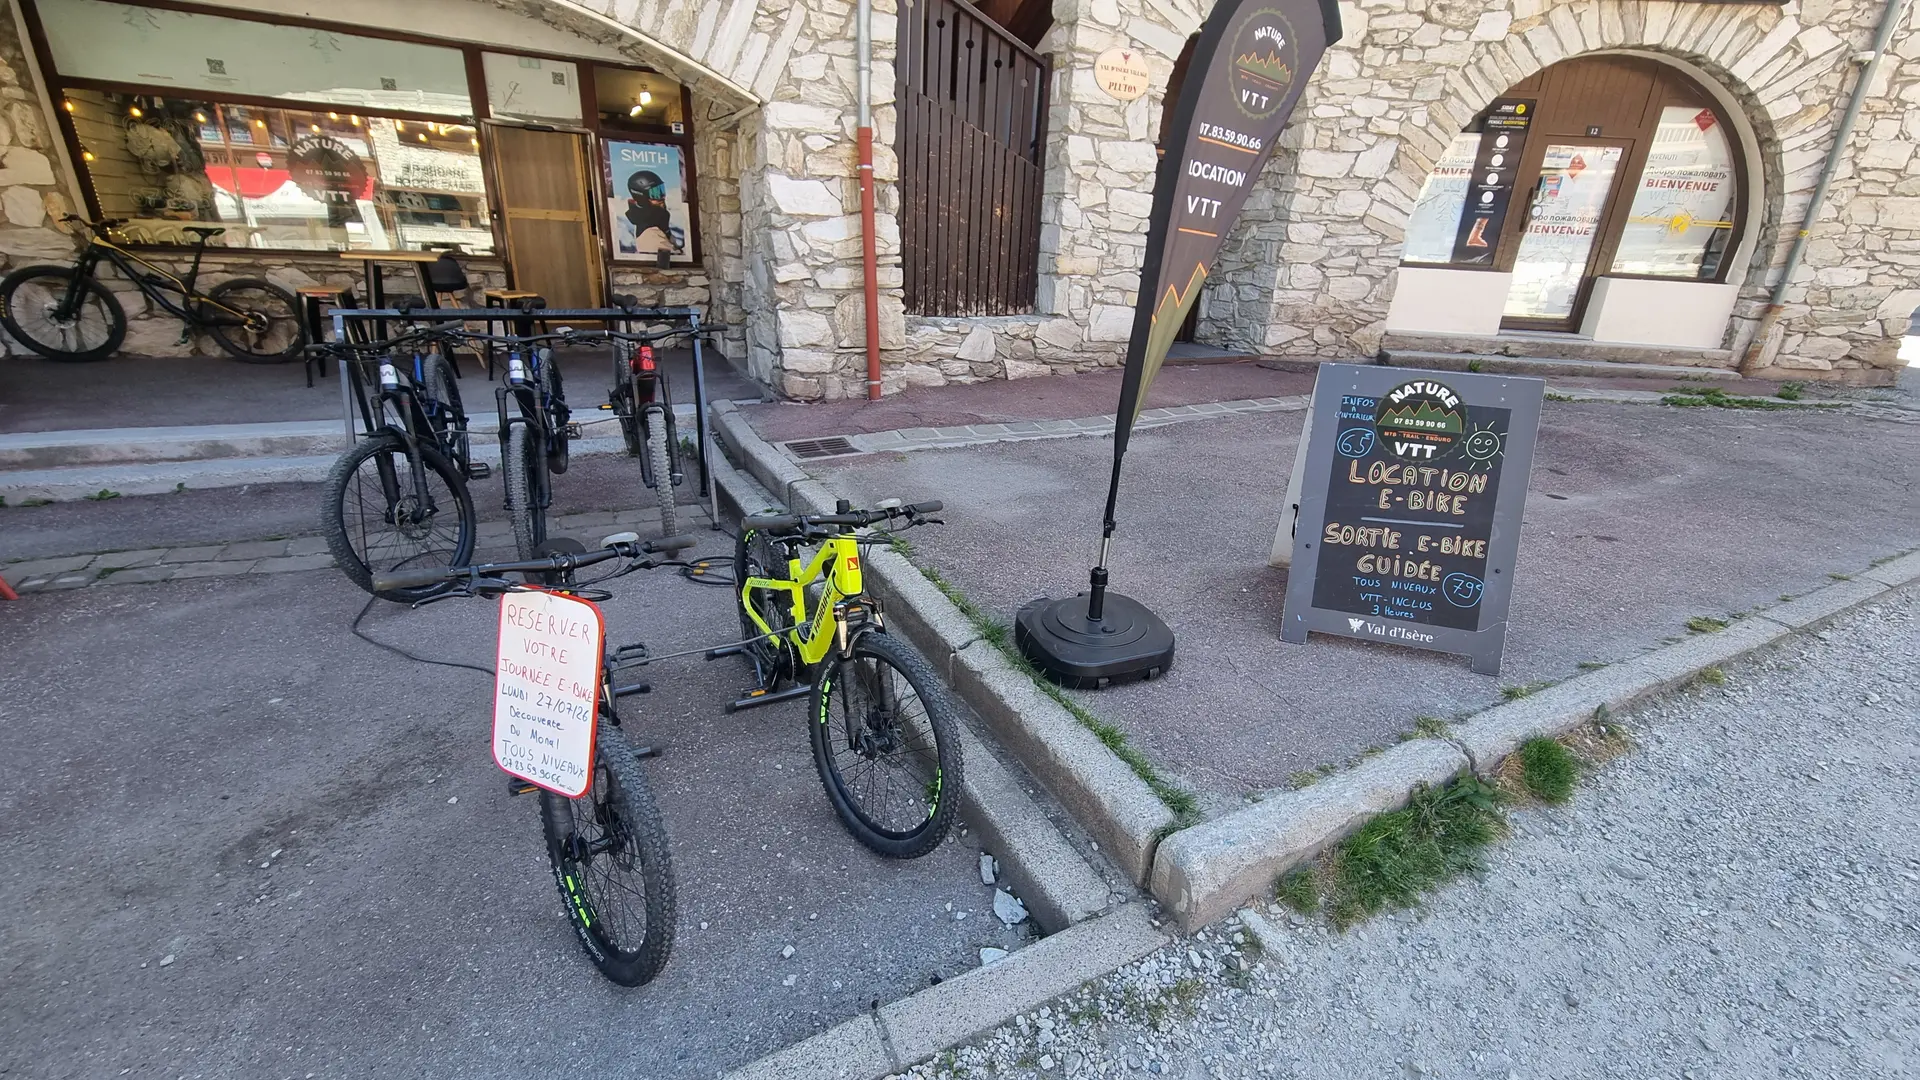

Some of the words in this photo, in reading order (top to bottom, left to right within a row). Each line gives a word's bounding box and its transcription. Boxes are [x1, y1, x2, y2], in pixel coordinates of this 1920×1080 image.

[1254, 26, 1286, 50] NATURE
[1242, 89, 1269, 109] VTT
[466, 116, 476, 124] 26
[1590, 127, 1599, 135] 12
[293, 139, 354, 161] NATURE
[620, 149, 668, 164] SMITH
[1649, 153, 1678, 161] NVENUTI
[1188, 159, 1247, 188] LOCATION
[1677, 169, 1727, 179] пожаловать
[1646, 178, 1719, 192] BIENVENUE
[314, 189, 350, 202] VTT
[1187, 195, 1221, 219] VTT
[1529, 224, 1592, 236] IENVENUE
[1342, 396, 1375, 407] INFOS
[1389, 382, 1460, 409] NATURE
[1415, 419, 1425, 427] 59
[1425, 419, 1436, 428] 90
[1436, 420, 1447, 429] 66
[1425, 435, 1452, 443] ENDURO
[1394, 441, 1437, 459] VTT
[1352, 576, 1381, 588] TOUS
[814, 581, 834, 634] HAIBIKE
[1371, 604, 1380, 615] 3
[1384, 605, 1415, 619] Heures
[507, 604, 590, 645] RESERVER
[1366, 622, 1386, 636] Val
[1389, 627, 1434, 643] d'Isère
[523, 638, 568, 665] VOTRE
[500, 658, 552, 687] JOURNÉE
[501, 683, 528, 702] LUNDI
[536, 692, 589, 722] 27/07/26
[510, 724, 521, 737] Du
[530, 729, 560, 750] Monal
[502, 739, 534, 761] TOUS
[541, 753, 585, 779] NIVEAUX
[502, 757, 513, 768] 07
[563, 891, 578, 919] BLACK
[579, 927, 605, 962] SCHWALBE
